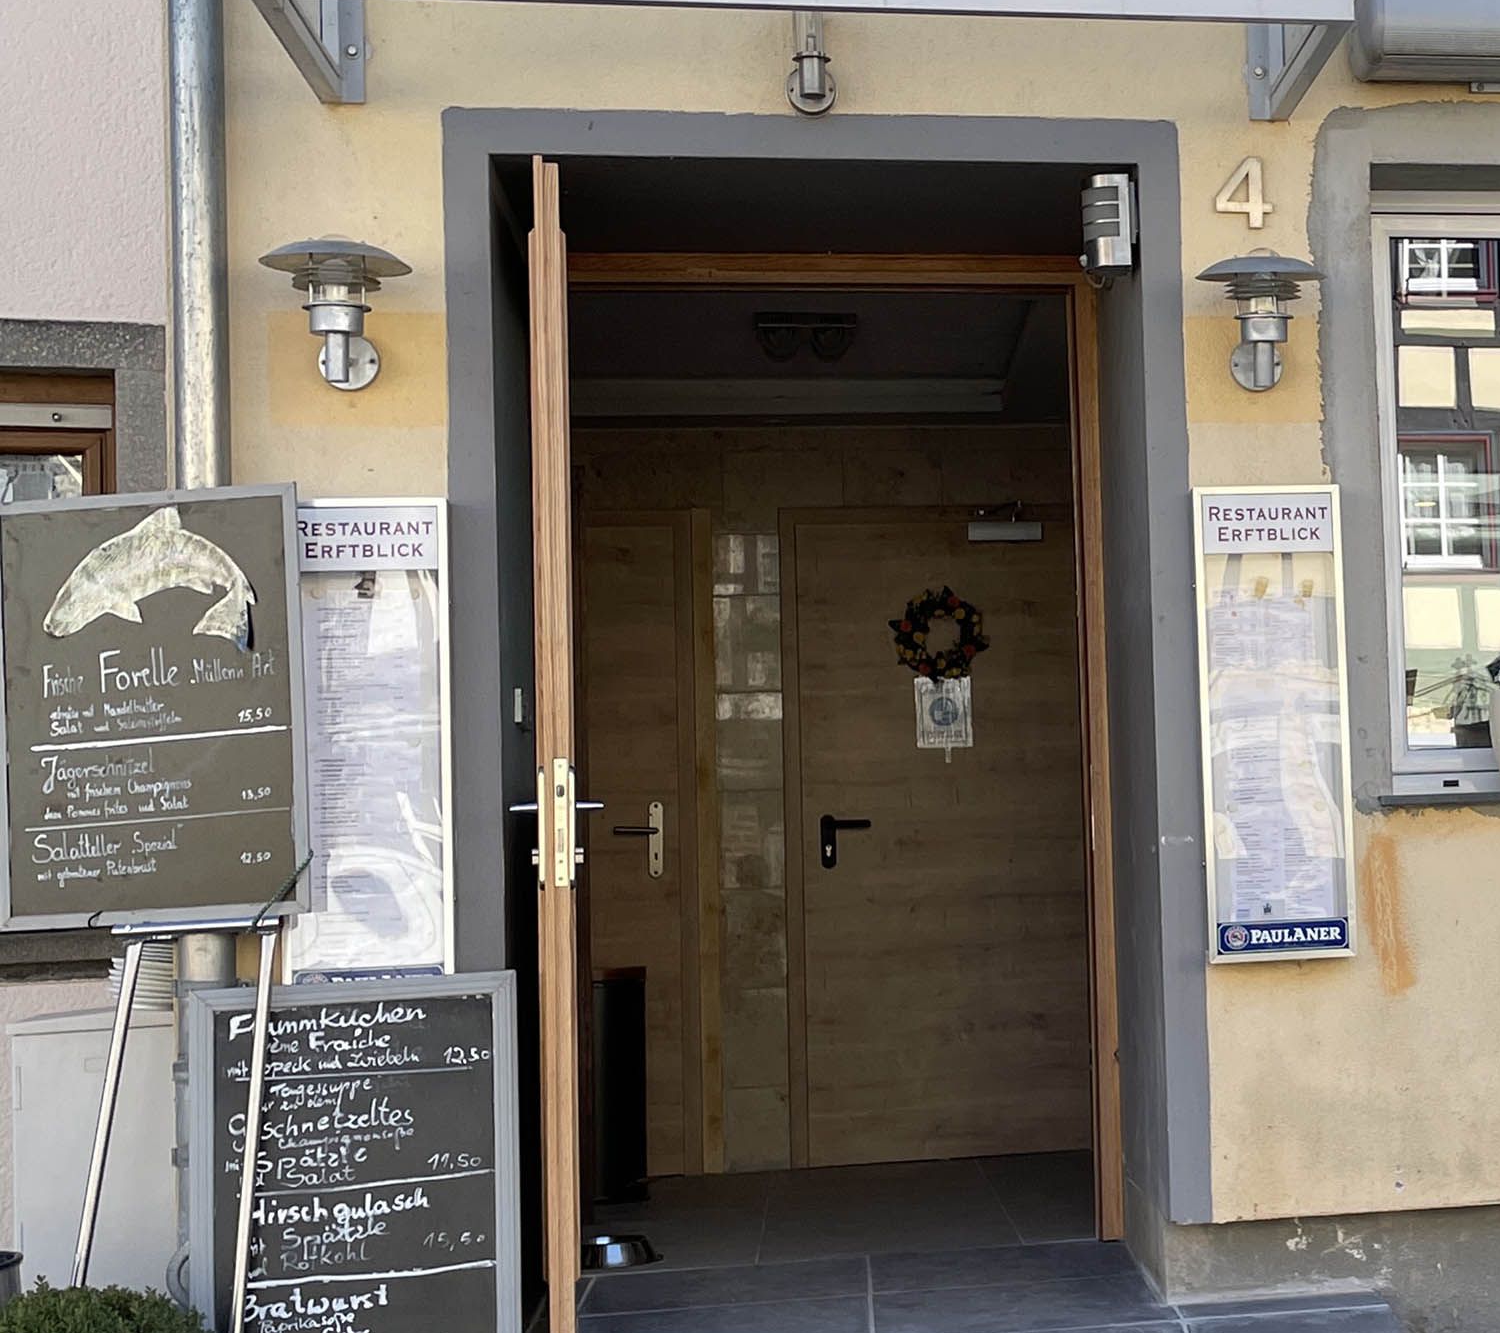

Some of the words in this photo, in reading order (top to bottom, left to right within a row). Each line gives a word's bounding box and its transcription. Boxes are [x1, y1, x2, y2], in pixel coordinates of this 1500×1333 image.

[1214, 155, 1274, 229] 4
[1208, 505, 1329, 522] RESTAURANT
[297, 520, 433, 537] RESTAURANT
[1217, 526, 1321, 543] ERFTBLICK
[305, 542, 424, 559] ERFTBLICK
[98, 647, 180, 693] Forelle
[50, 719, 83, 737] Salat
[41, 747, 155, 795] Jägerschnitzel
[160, 795, 190, 811] Salat
[32, 831, 122, 864] Salatteller
[1250, 926, 1342, 945] PAULANER
[347, 1047, 420, 1068] Zwiebeln
[270, 1077, 373, 1109] Tagessuppe
[228, 1096, 414, 1144] Gschnetzeltes
[279, 1167, 356, 1188] Salat
[281, 1242, 371, 1271] Rotkohl
